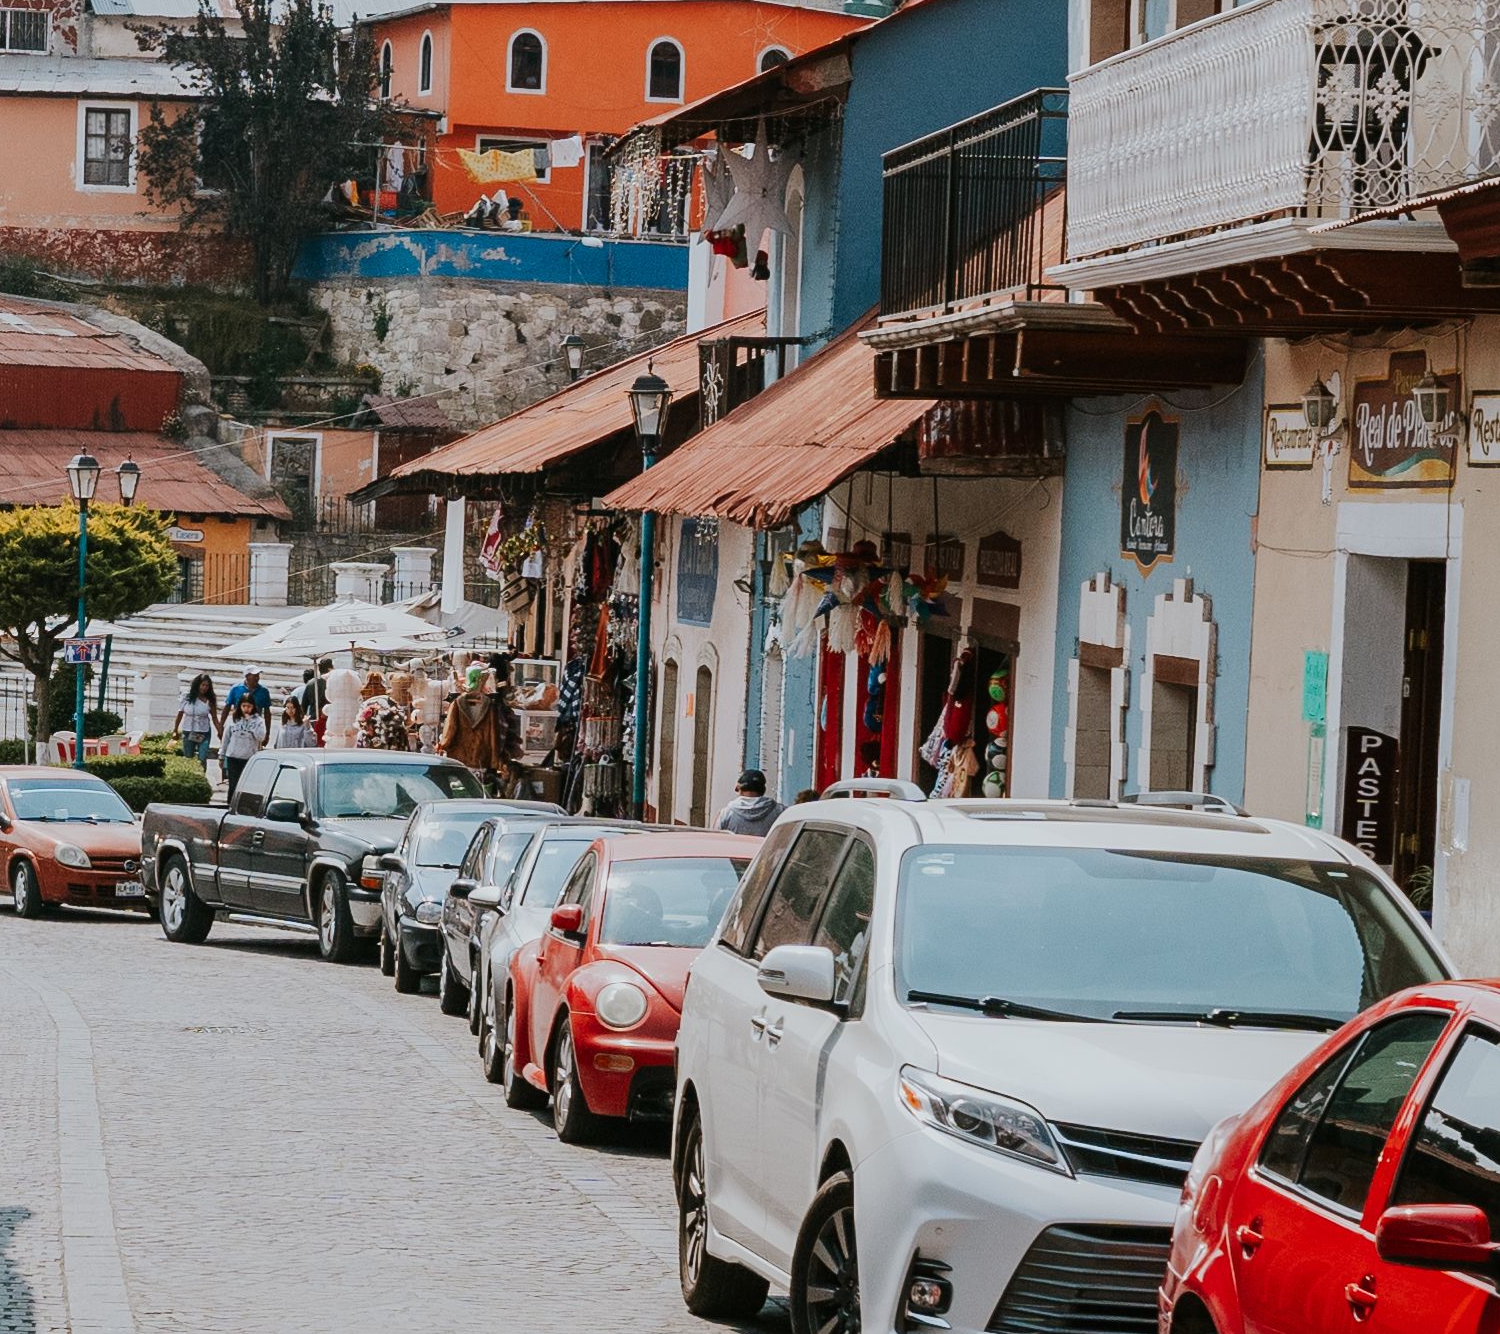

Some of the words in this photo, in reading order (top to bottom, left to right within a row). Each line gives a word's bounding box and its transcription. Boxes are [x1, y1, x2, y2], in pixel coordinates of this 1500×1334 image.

[1357, 402, 1386, 466] Real
[1386, 402, 1401, 448] de
[1130, 497, 1164, 537] Cantera
[1355, 735, 1383, 859] PASTES
